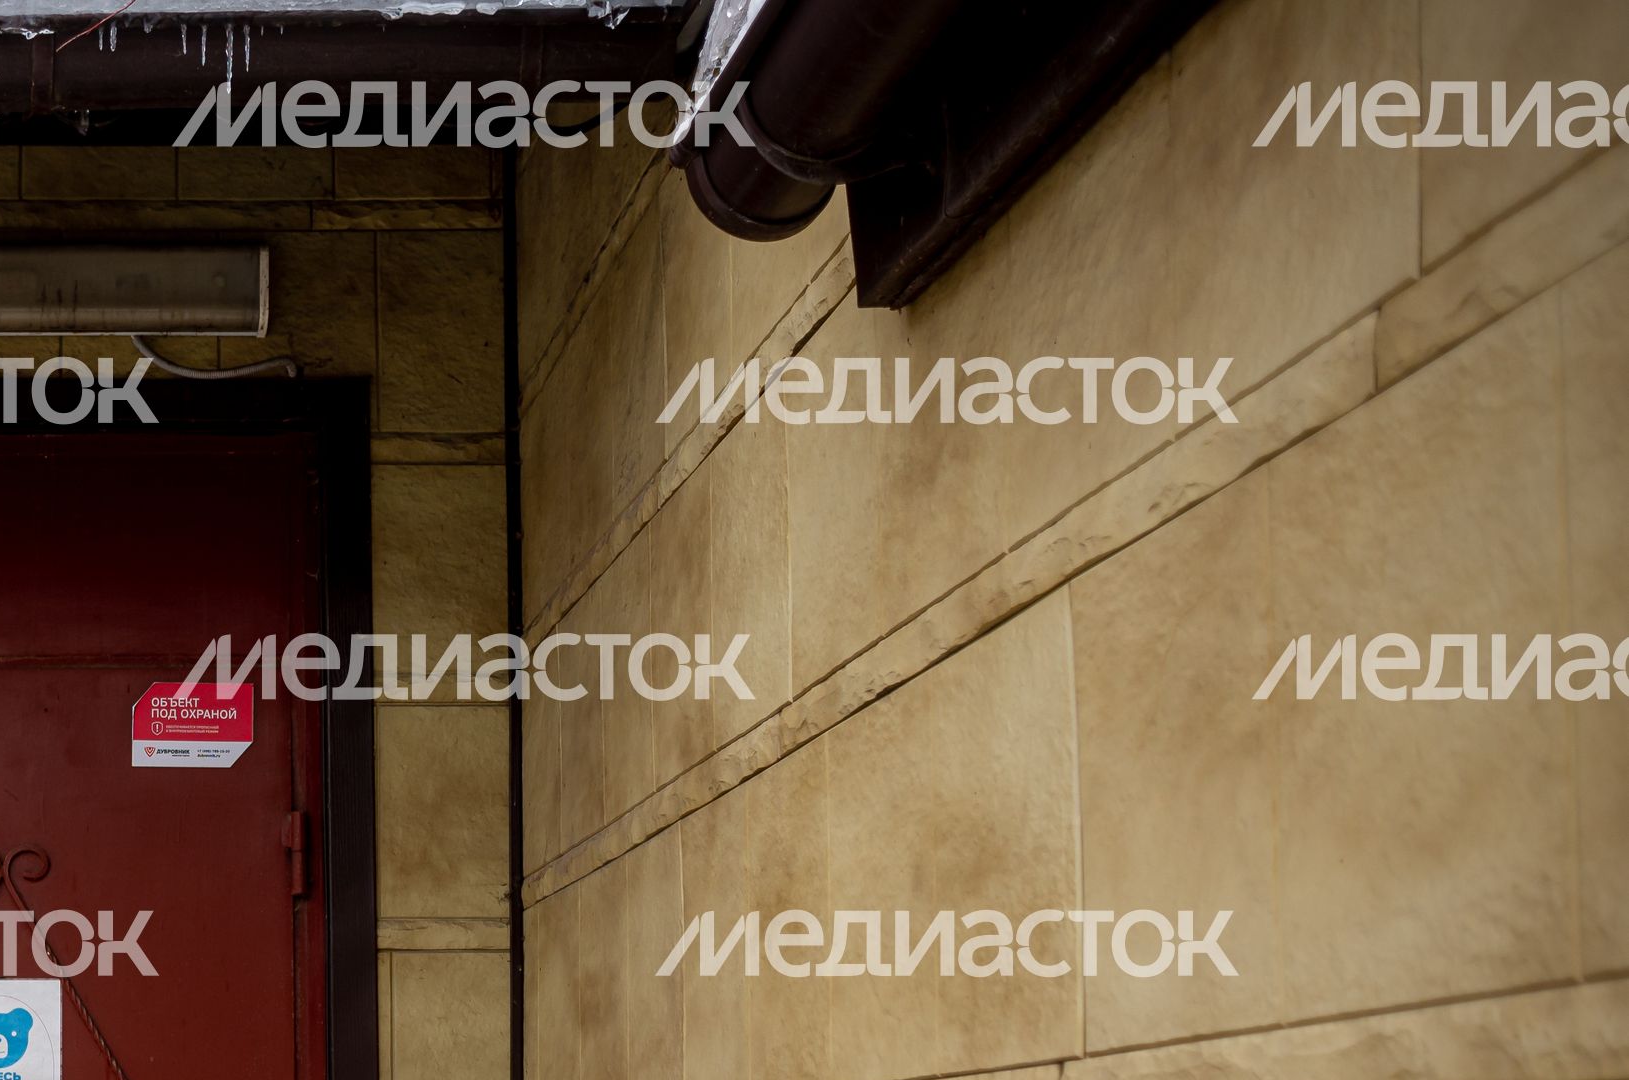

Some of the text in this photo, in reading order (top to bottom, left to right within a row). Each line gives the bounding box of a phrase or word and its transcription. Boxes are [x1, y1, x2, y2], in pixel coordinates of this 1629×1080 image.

[152, 698, 199, 707] ОБЪЕКТ
[151, 708, 236, 720] ПОД ОХРАНОЙ
